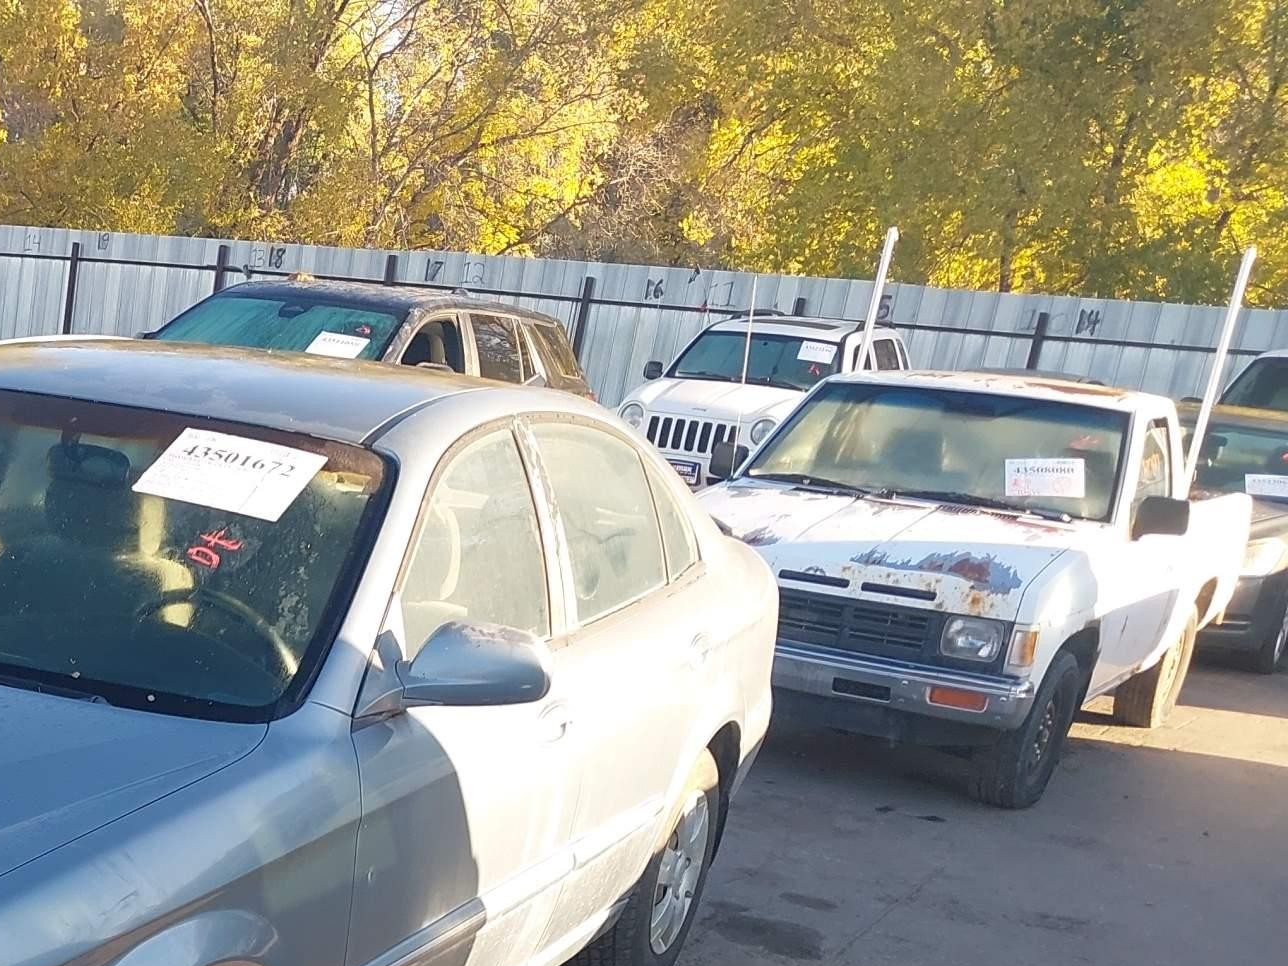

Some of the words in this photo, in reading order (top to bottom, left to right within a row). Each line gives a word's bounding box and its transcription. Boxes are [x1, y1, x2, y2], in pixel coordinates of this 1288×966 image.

[23, 233, 42, 252] 14
[268, 246, 287, 269] 18
[424, 258, 445, 282] 17
[462, 261, 486, 285] 12
[183, 443, 297, 478] 43501672
